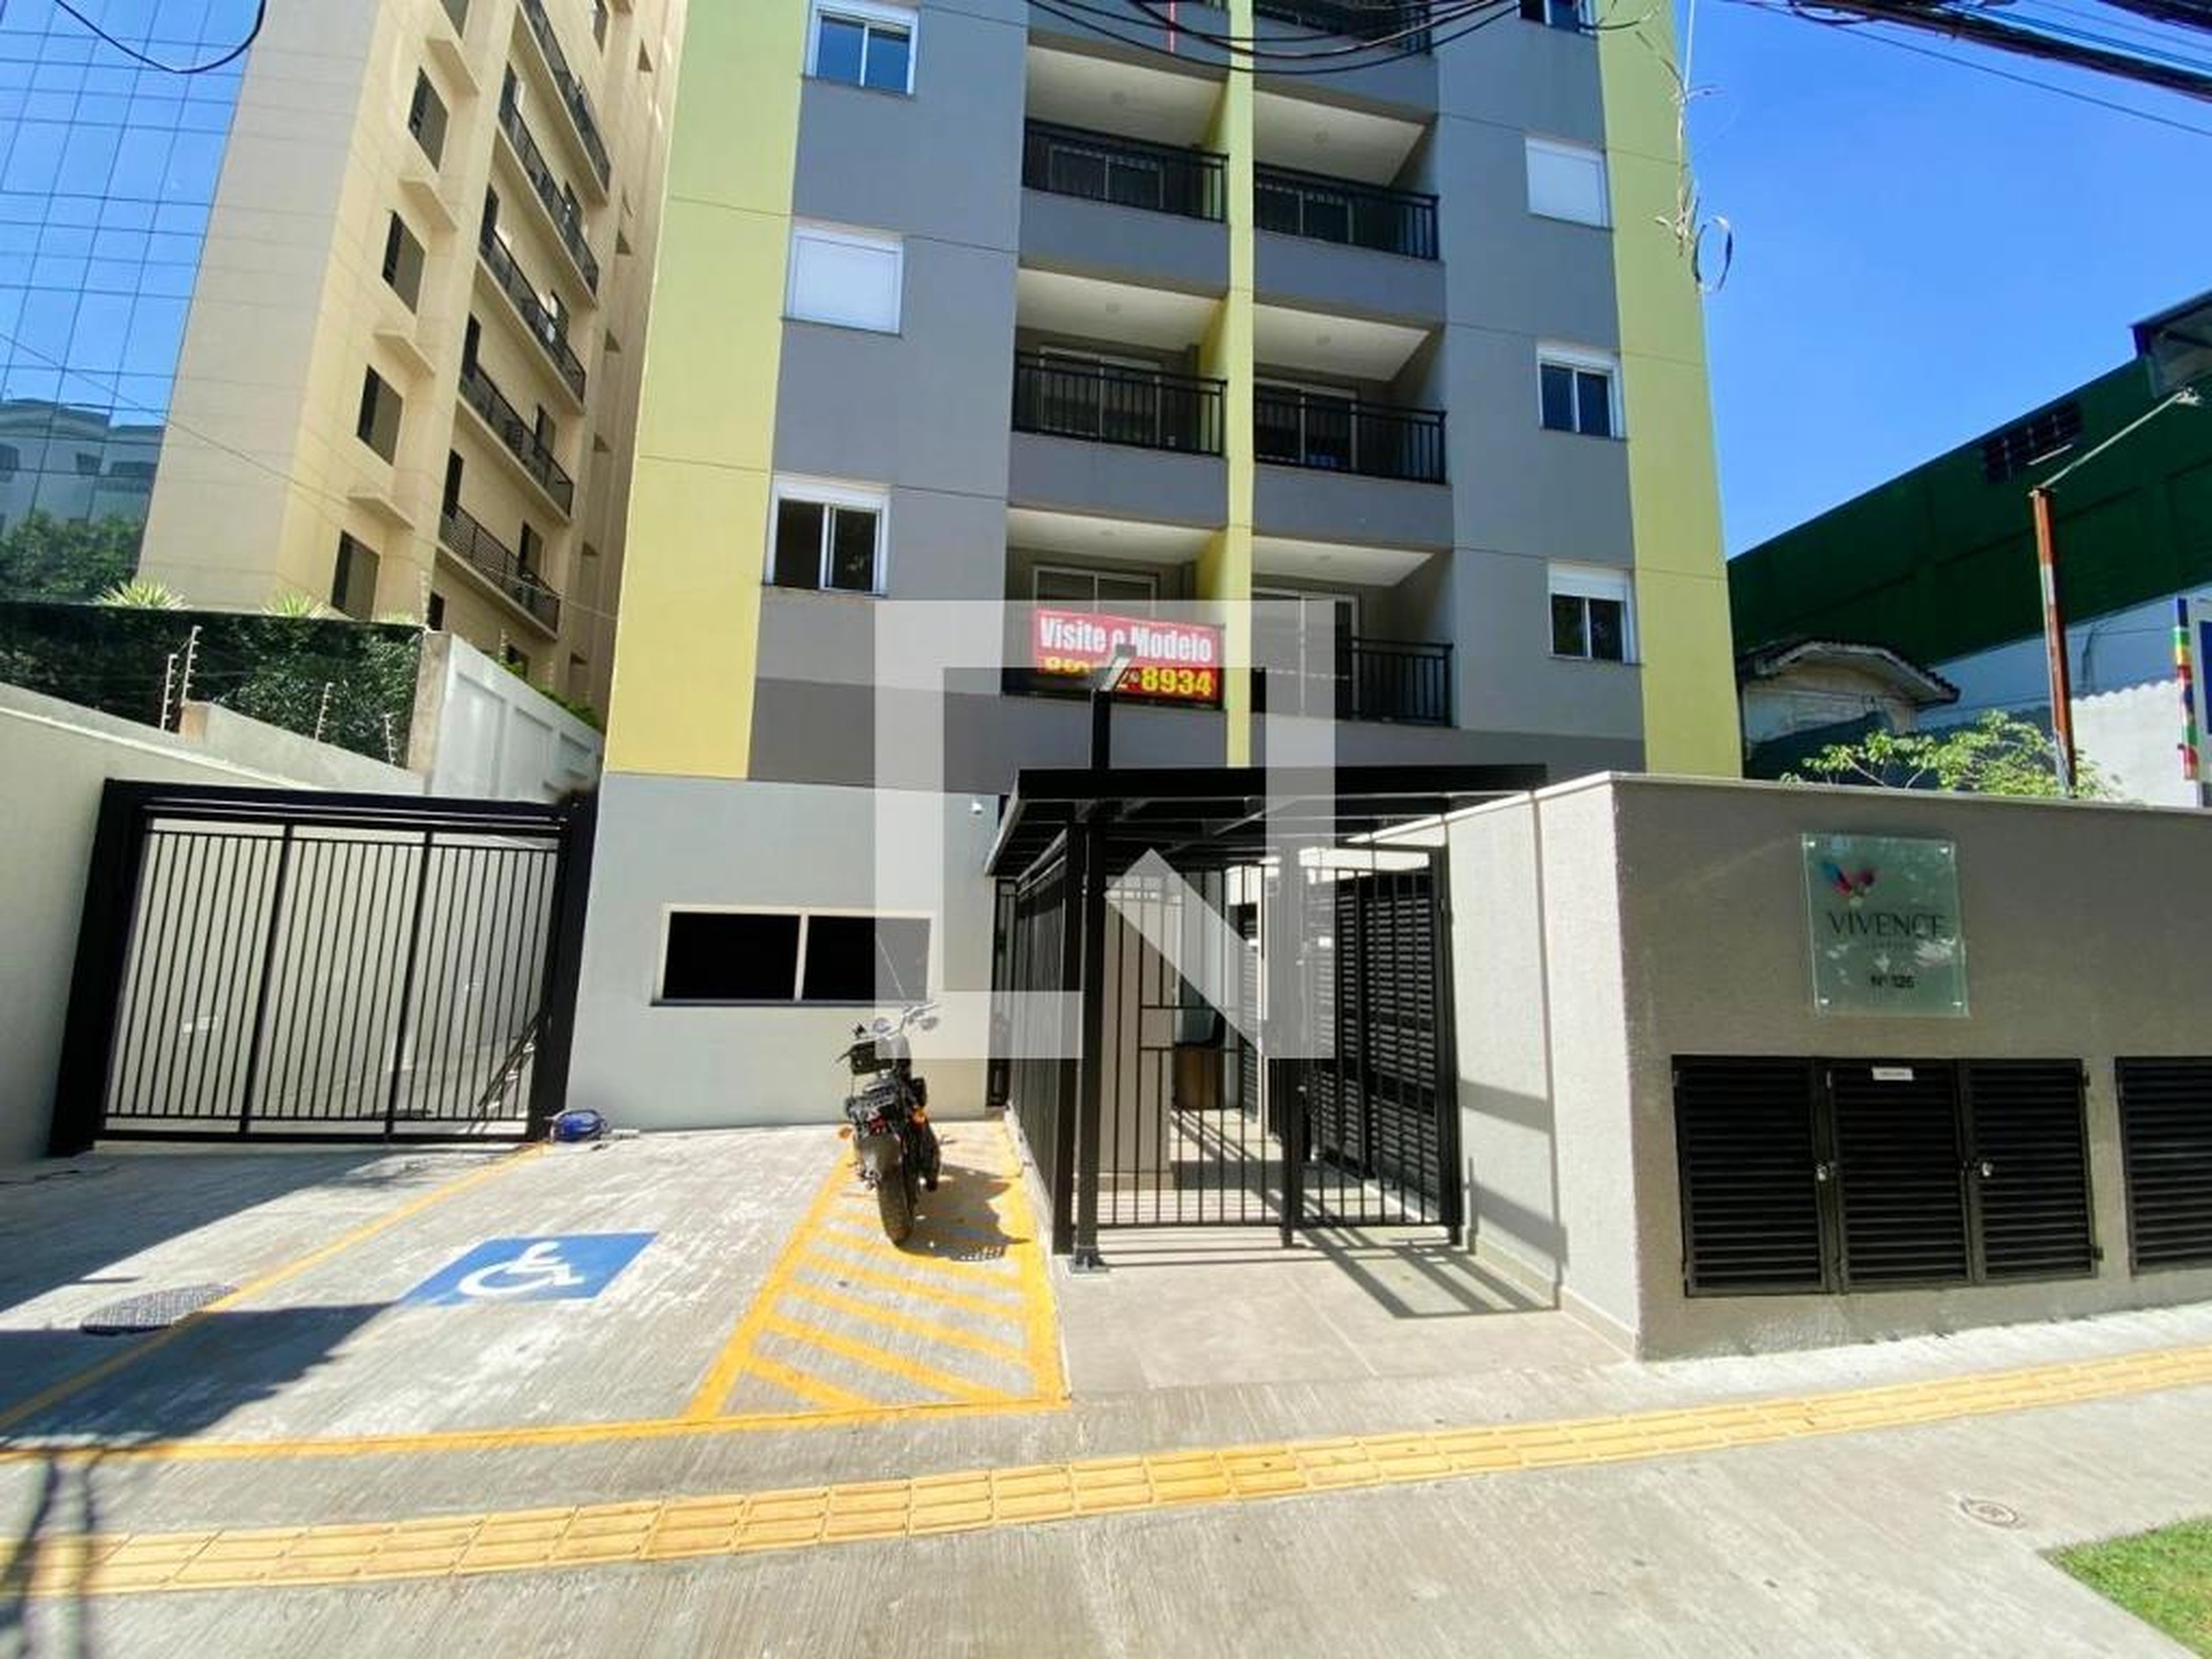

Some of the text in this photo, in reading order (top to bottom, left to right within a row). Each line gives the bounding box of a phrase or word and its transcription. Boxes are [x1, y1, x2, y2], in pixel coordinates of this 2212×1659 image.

[1040, 618, 1106, 652] Visite
[1130, 625, 1212, 662] Modelo
[1827, 911, 1948, 939] VIVENCE
